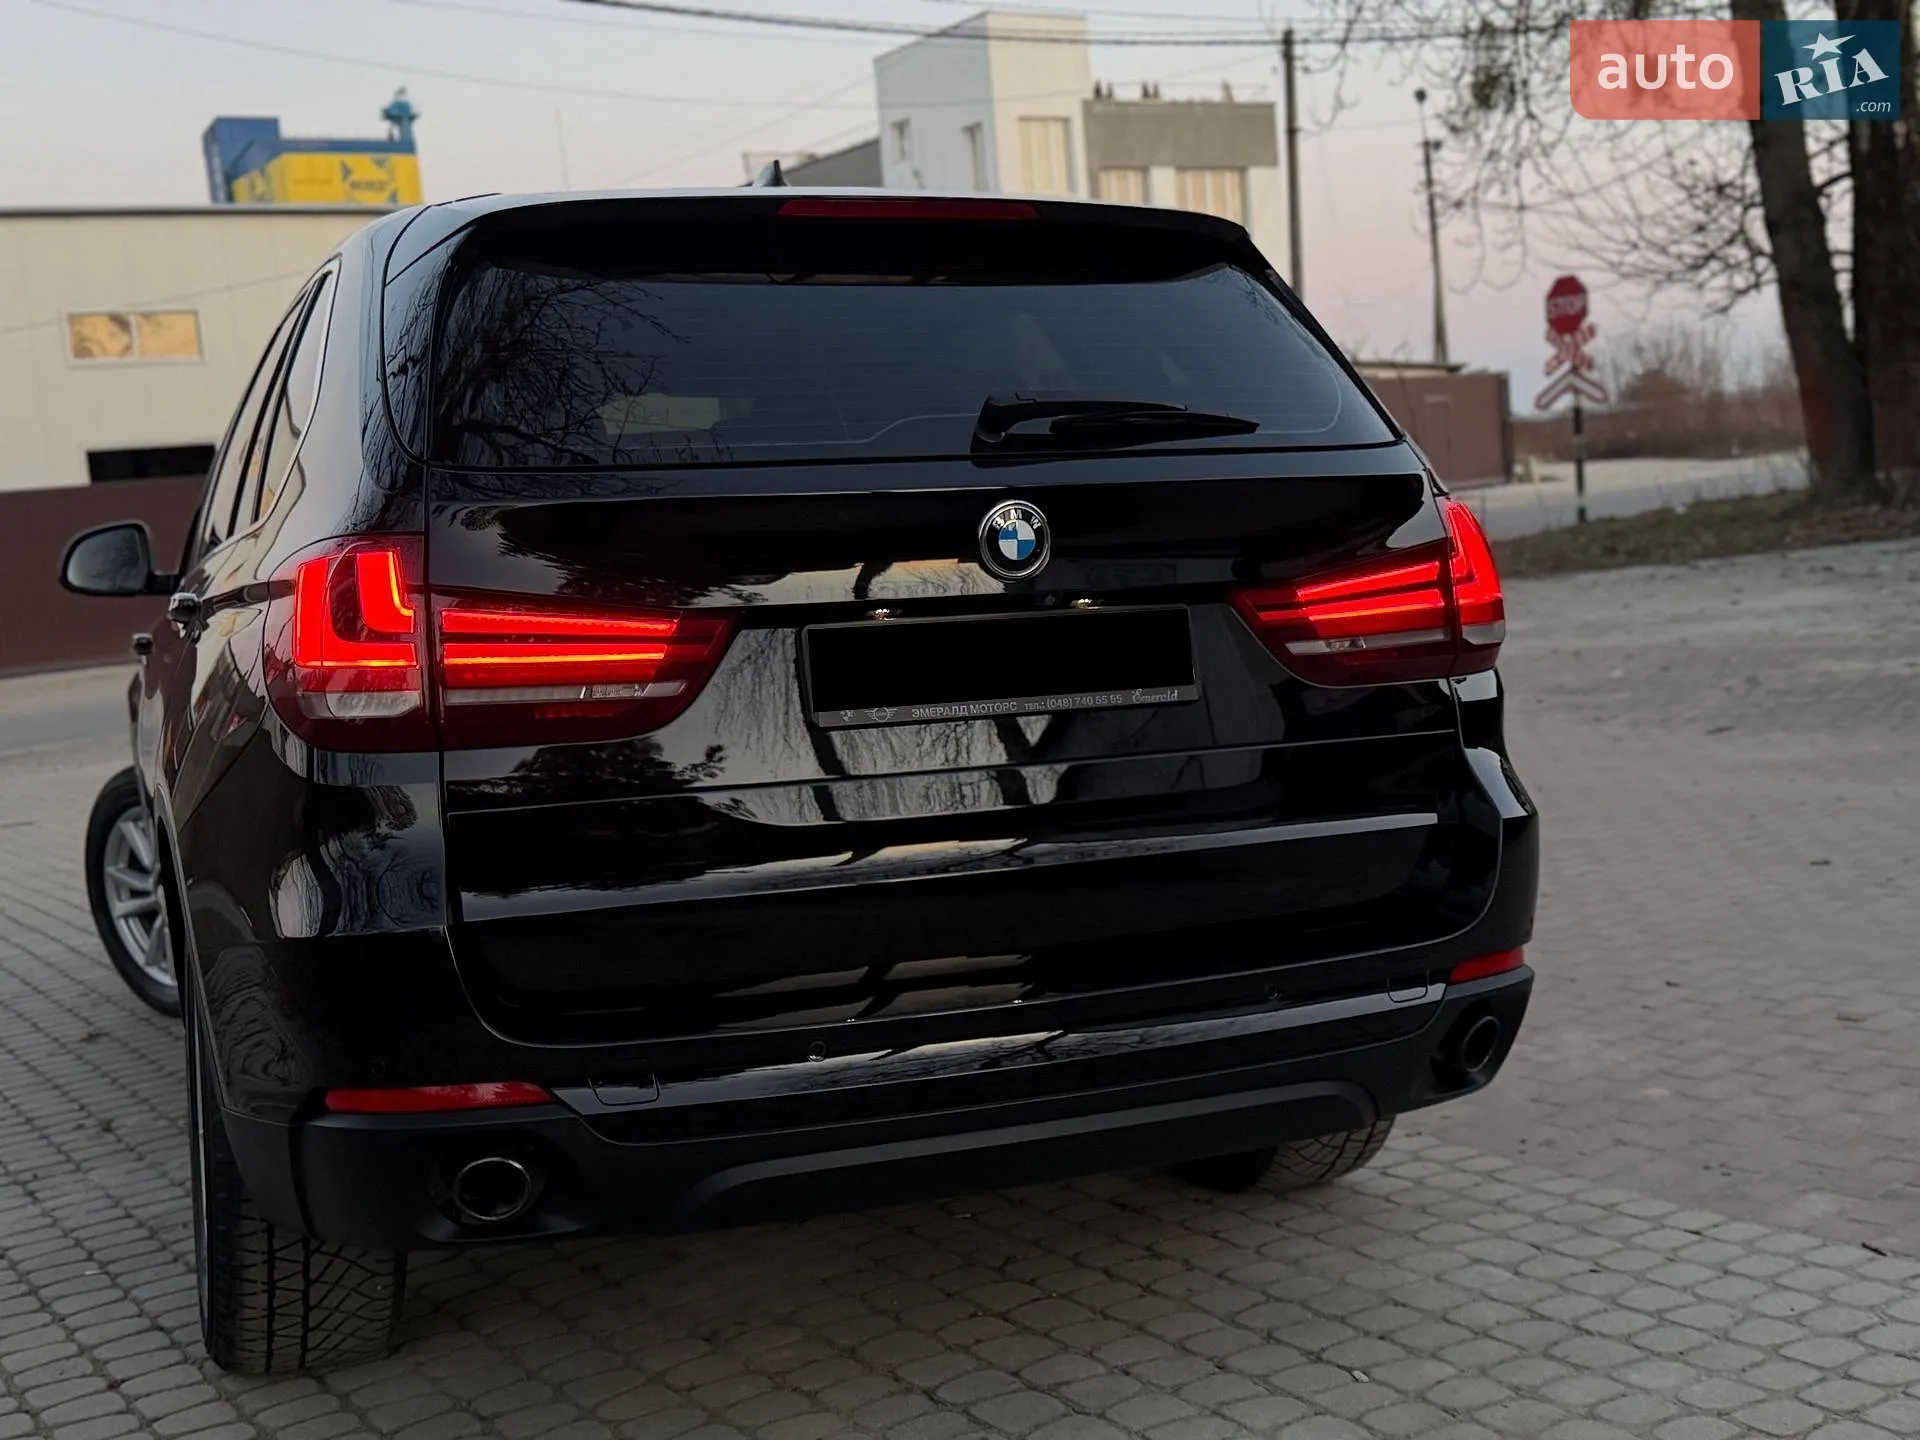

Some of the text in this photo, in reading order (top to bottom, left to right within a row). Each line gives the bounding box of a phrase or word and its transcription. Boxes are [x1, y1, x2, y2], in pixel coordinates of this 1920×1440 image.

[1547, 294, 1587, 317] STOP
[992, 508, 1042, 530] BMW
[911, 705, 969, 719] ЭМЕРАЛД
[970, 701, 1018, 715] МОТОРС
[1046, 696, 1073, 711] (048)
[1074, 695, 1094, 706] 740
[1095, 694, 1108, 705] 55
[1110, 693, 1123, 704] 55
[1131, 688, 1179, 704] Emerald
